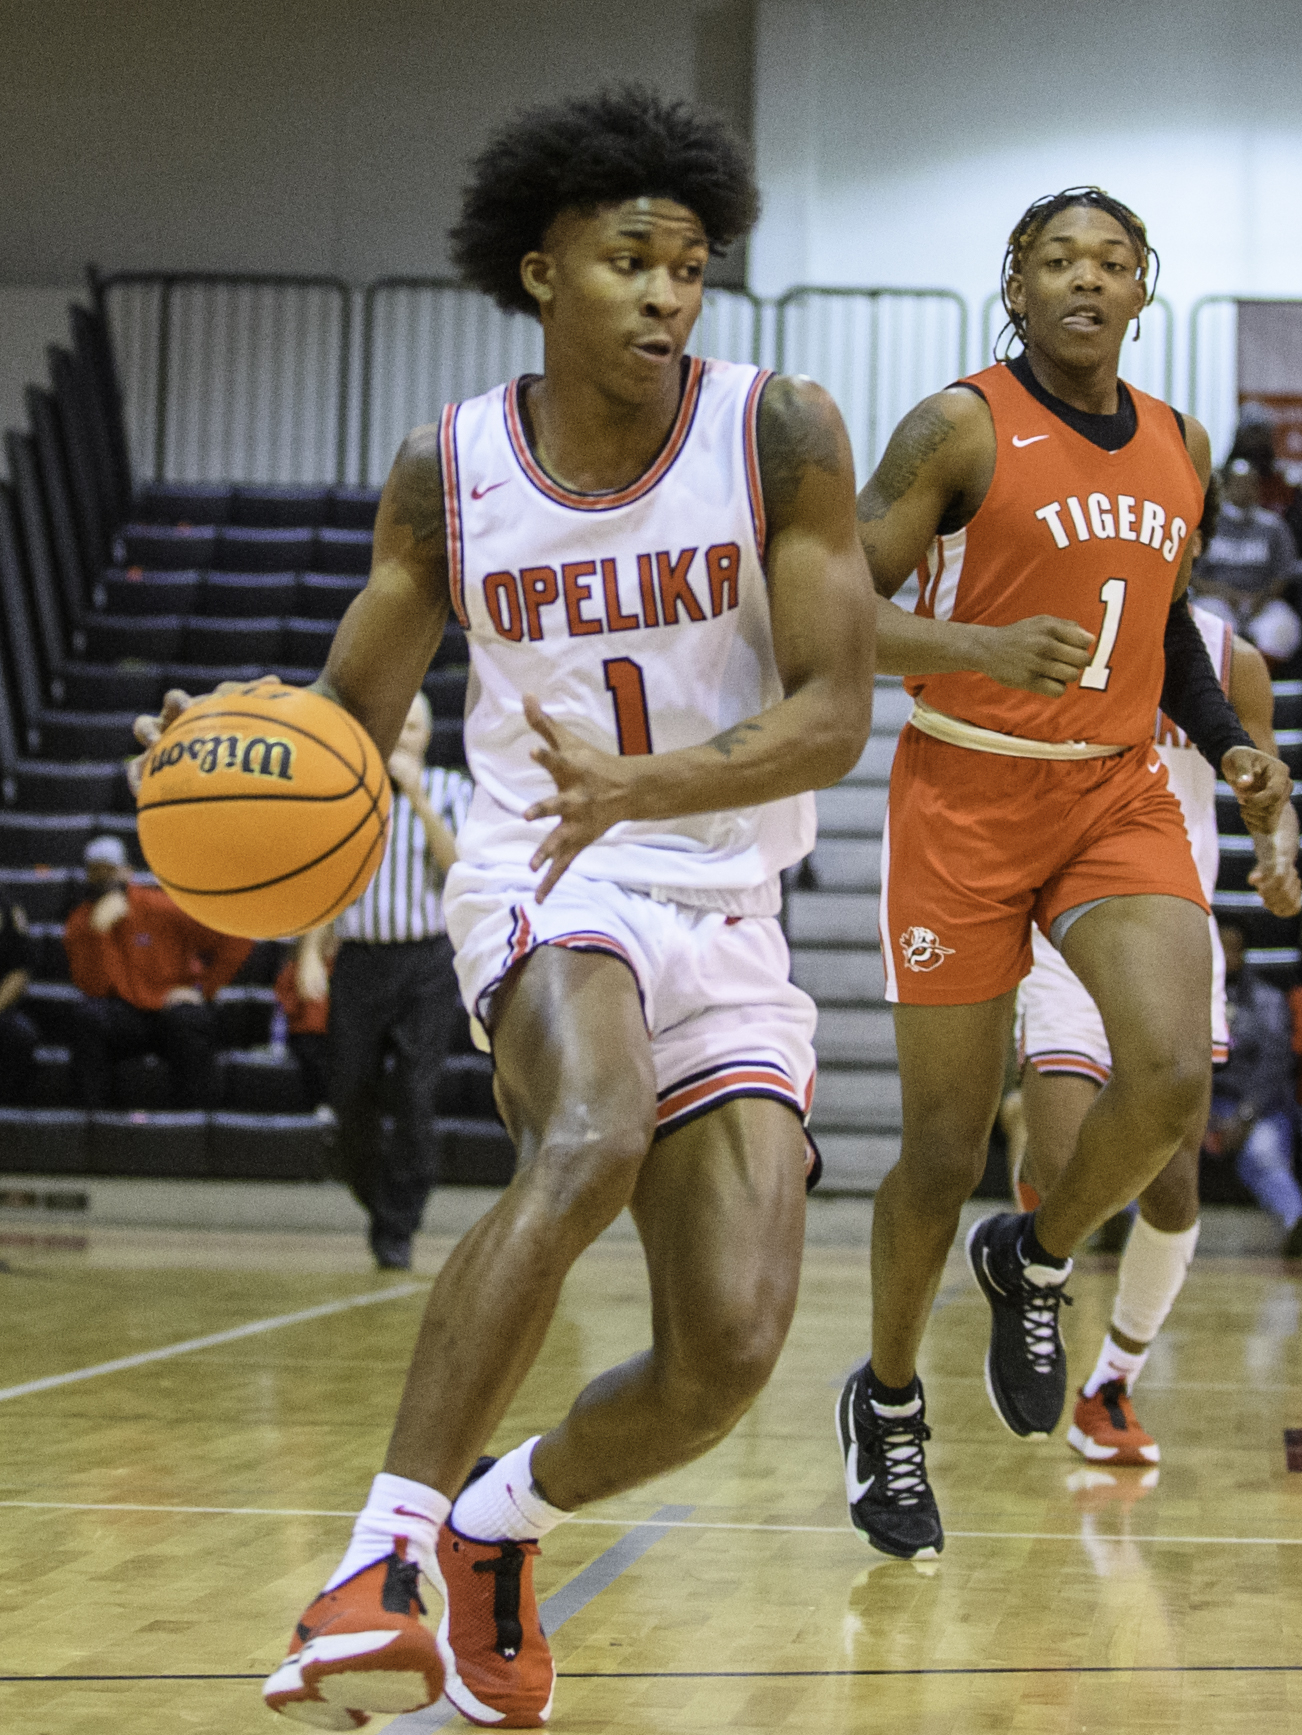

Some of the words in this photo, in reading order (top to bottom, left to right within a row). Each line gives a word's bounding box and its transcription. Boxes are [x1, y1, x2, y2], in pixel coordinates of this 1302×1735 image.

[1034, 491, 1187, 563] TIGERS
[482, 541, 741, 642] OPELIKA
[1079, 576, 1128, 693] 1
[602, 656, 653, 756] 1
[149, 735, 295, 781] Wilson
